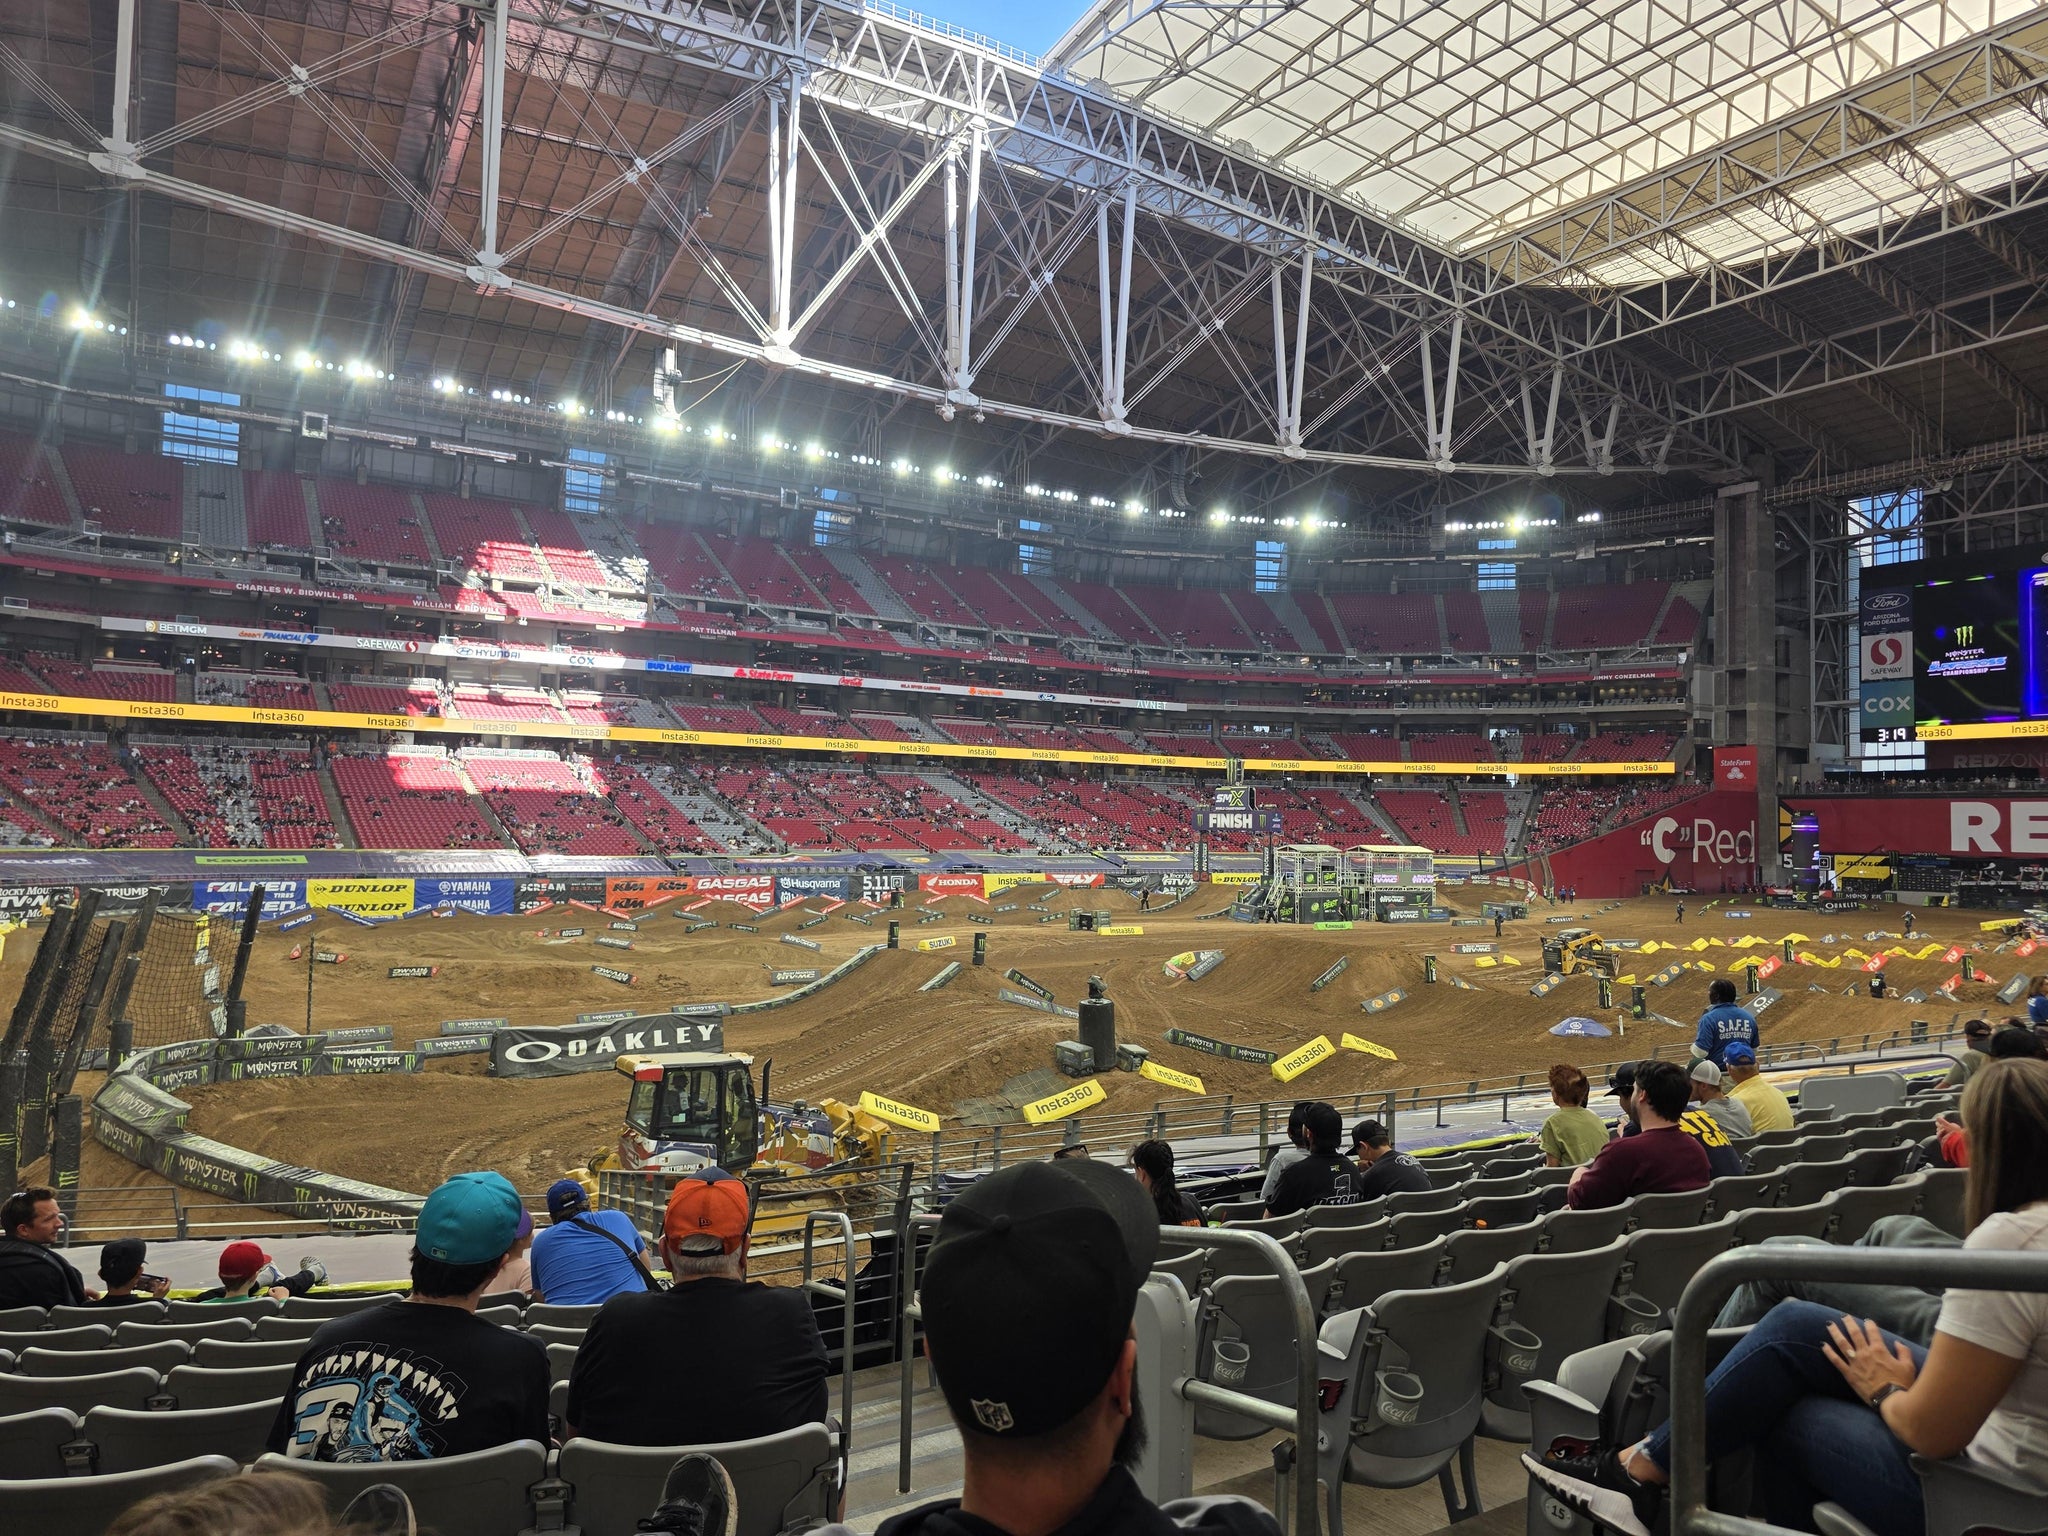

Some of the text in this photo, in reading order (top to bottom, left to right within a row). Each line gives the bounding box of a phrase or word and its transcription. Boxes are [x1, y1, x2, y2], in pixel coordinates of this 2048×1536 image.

[236, 583, 357, 600] CHARLES W. BIDWILL, SR.
[412, 600, 451, 609] WILLIAM
[1872, 595, 1900, 609] Ford
[1863, 617, 1910, 627] FORD DEALERS
[1872, 613, 1900, 621] ARIZONA
[159, 623, 207, 635] BETMGM
[690, 626, 706, 634] PAT
[706, 628, 737, 636] TILLMAN
[262, 632, 302, 642] FINANCIAL
[356, 639, 404, 650] SAFEWAY
[475, 649, 521, 659] HYUNDAI
[1945, 648, 1985, 658] MONSTER
[569, 656, 595, 666] COX
[647, 662, 691, 672] BUD LIGHT
[1870, 667, 1903, 676] SAFEWAY
[1942, 668, 1989, 677] CHAMPIONSHIP
[749, 669, 794, 681] State Farm
[2, 695, 59, 709] Insta360
[1136, 700, 1168, 711] AVNET
[1864, 696, 1911, 713] COX
[129, 704, 184, 717] Insta360
[252, 711, 304, 723] Insta360
[367, 717, 414, 728] Insta360
[472, 722, 517, 733] Insta360
[570, 727, 611, 737] Insta360
[1916, 728, 1953, 738] sta360
[661, 732, 700, 742] Insta360
[1878, 728, 1906, 741] 3:19
[746, 736, 782, 746] Insta360
[825, 741, 859, 750] Insta360
[899, 744, 930, 753] Insta360
[967, 748, 997, 756] Insta360
[1032, 751, 1060, 760] Insta360
[1093, 754, 1119, 763] Insta360
[1151, 757, 1176, 765] Insta360
[1206, 759, 1227, 767] Insta3
[1271, 761, 1300, 769] Insta360
[1336, 763, 1365, 771] Insta360
[1404, 763, 1436, 772] Insta360
[1475, 764, 1508, 772] Insta360
[1623, 764, 1659, 772] Insta360
[1720, 759, 1736, 767] State
[1215, 790, 1246, 807] SMX
[1208, 813, 1253, 829] FINISH
[1693, 818, 1756, 864] Red
[451, 881, 491, 892] YAMAHA
[612, 881, 645, 892] KTM
[656, 880, 688, 891] KTM
[697, 876, 771, 890] GASGAS
[791, 878, 841, 889] Husqvarna
[863, 875, 890, 890] 5.11
[938, 878, 978, 887] HONDA
[105, 887, 149, 900] TRIUMP
[329, 884, 407, 893] DUNLOP
[612, 898, 645, 908] KTM
[704, 892, 771, 905] ASGAS
[206, 900, 297, 913] FALEN
[1109, 927, 1135, 935] Insta360
[928, 938, 953, 949] SUZUKI
[1759, 960, 1775, 977] FLY
[1867, 957, 1882, 972] FLY
[1020, 977, 1044, 995] MONSTER
[1014, 994, 1041, 1006] MONSTER
[686, 1004, 716, 1013] MONSTER
[592, 1012, 625, 1022] MONSTER
[457, 1020, 494, 1029] MONSTER
[1718, 1019, 1752, 1034] S.A.F.E.
[337, 1026, 376, 1036] MONSTER
[257, 1039, 302, 1051] MONSTER
[435, 1038, 477, 1049] MONSTER
[568, 1023, 717, 1057] OAKLEY
[1185, 1035, 1214, 1049] MONSTER
[1354, 1037, 1392, 1058] Insta360
[1238, 1049, 1267, 1060] MONSTER
[1282, 1043, 1327, 1073] Insta360
[247, 1060, 298, 1074] MONSTER
[347, 1055, 401, 1069] MONSTER
[162, 1069, 199, 1086] MONSTER
[1154, 1067, 1197, 1089] Insta360
[116, 1090, 155, 1117] MONSTER
[1035, 1085, 1094, 1116] Insta360
[874, 1097, 930, 1125] Insta360
[100, 1118, 135, 1148] MONSTER
[178, 1154, 238, 1187] MONSTER
[183, 1174, 227, 1193] ENERGY
[1551, 1506, 1566, 1520] 15
